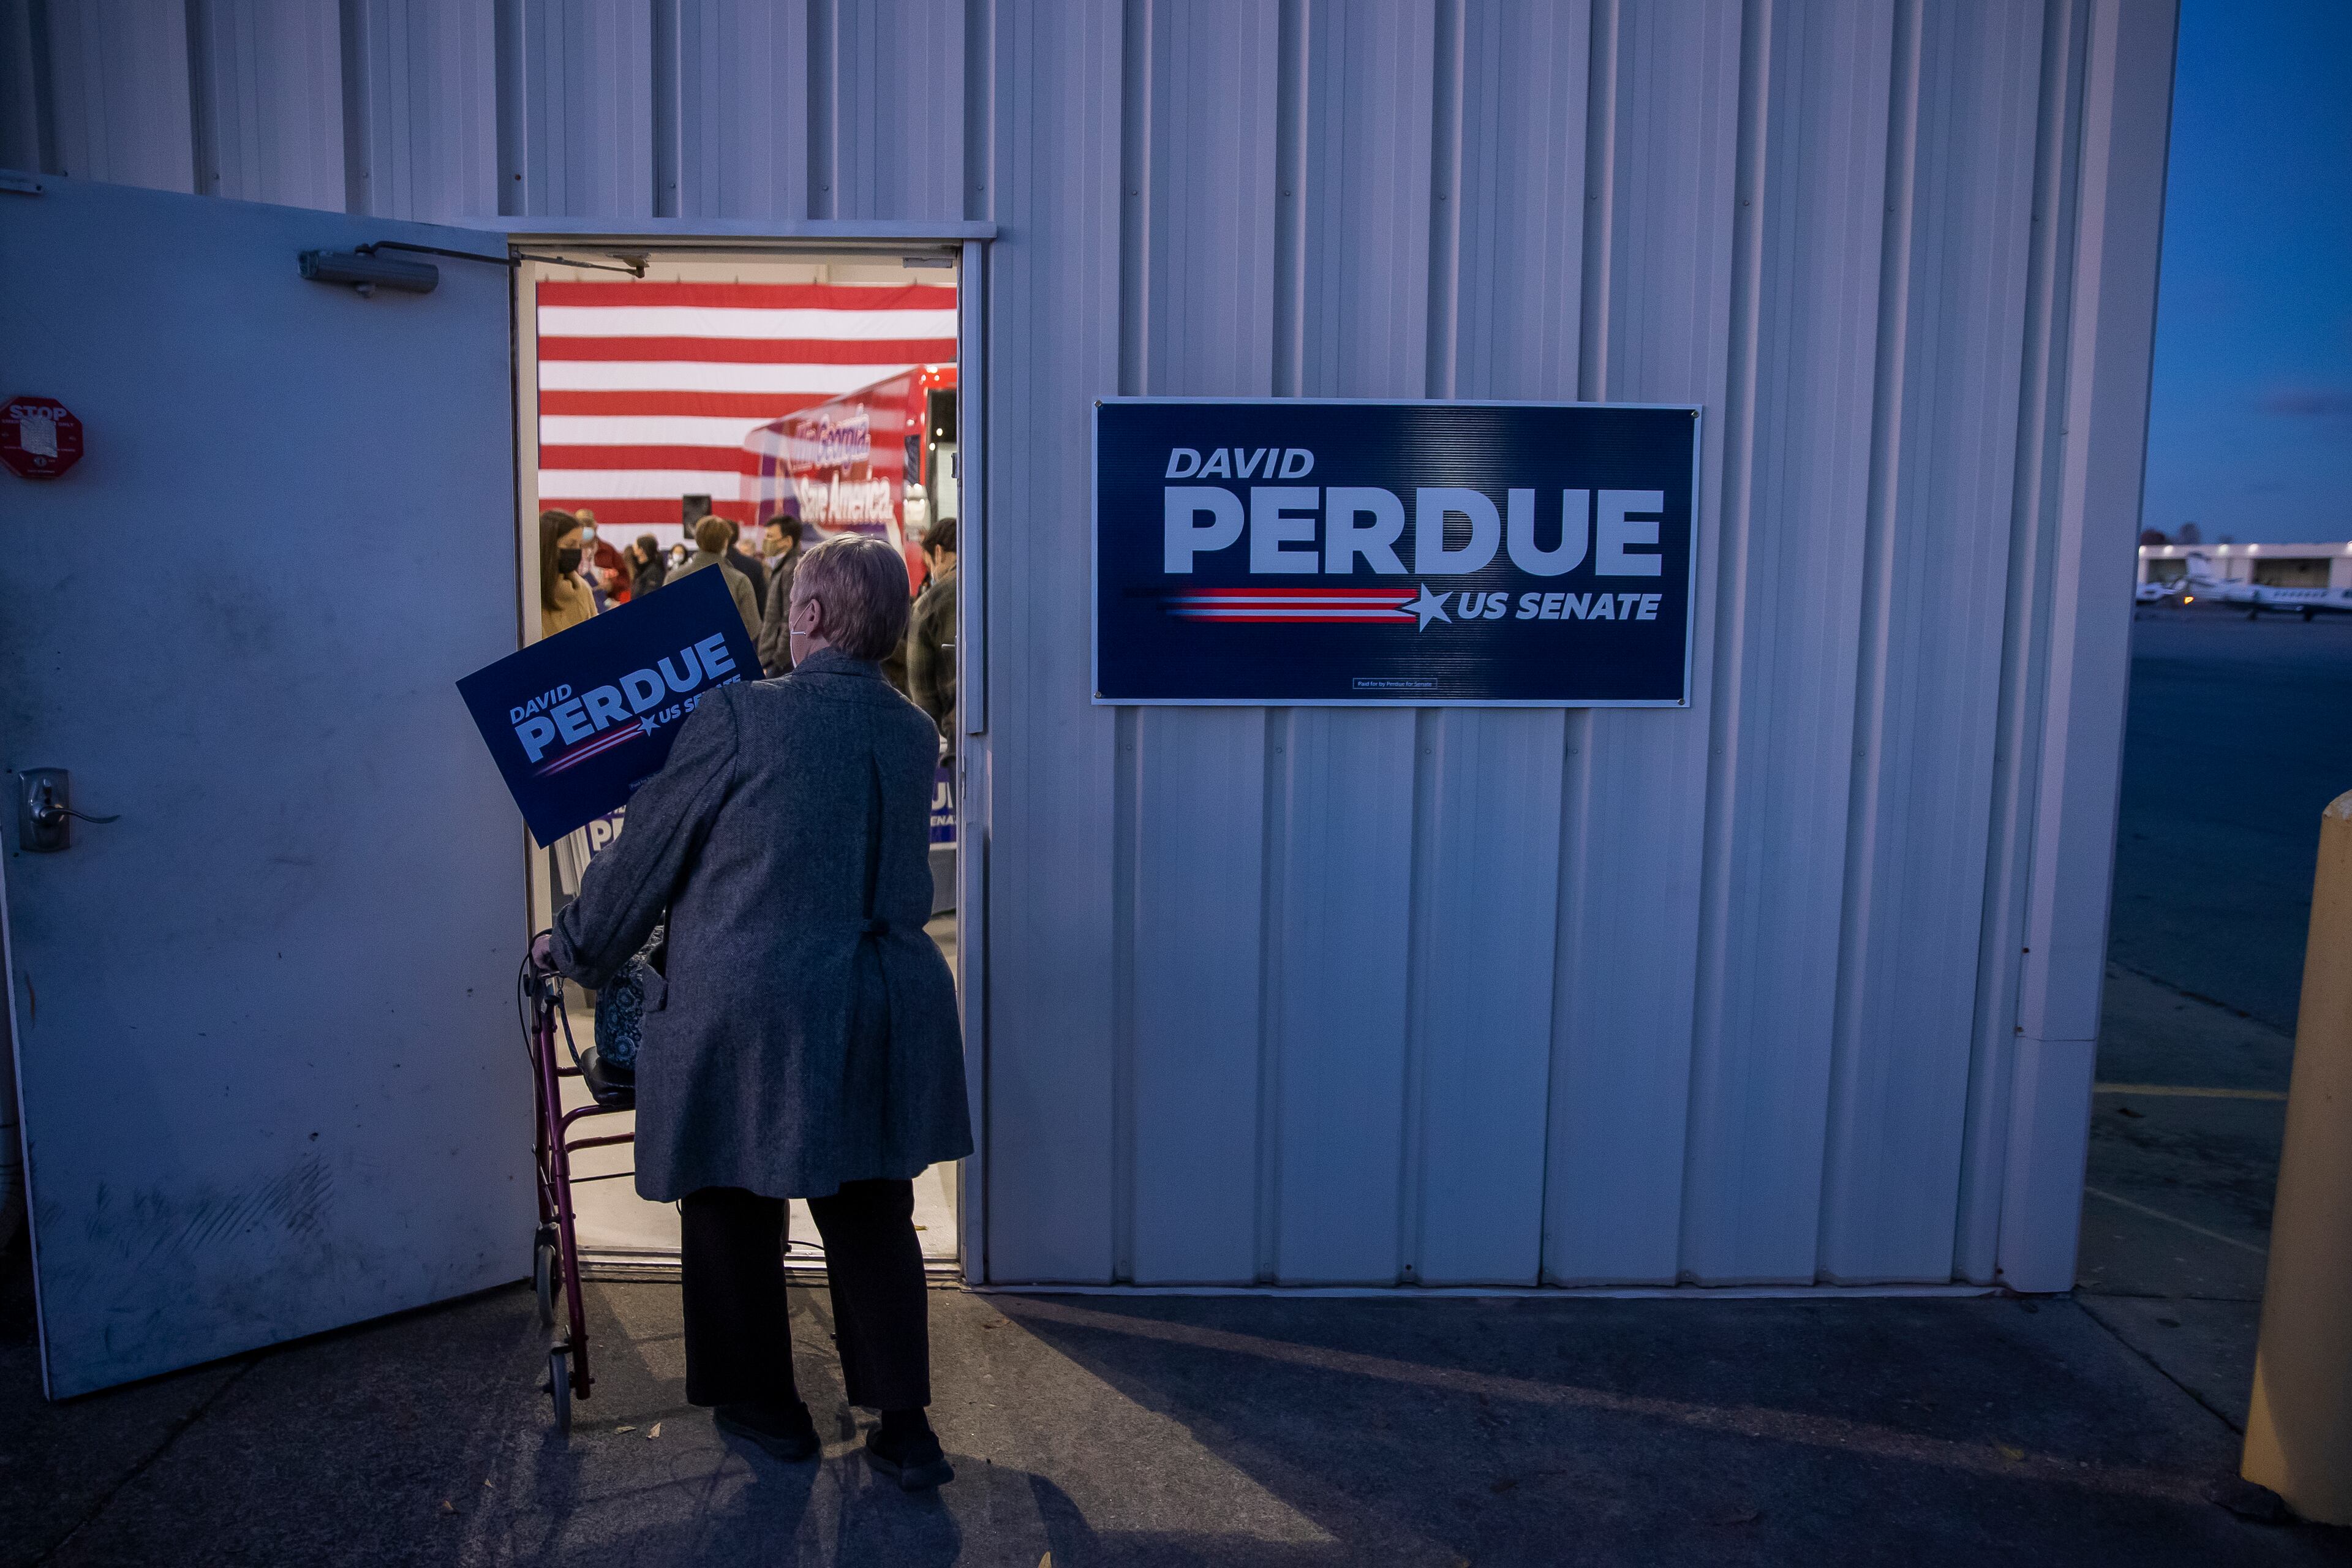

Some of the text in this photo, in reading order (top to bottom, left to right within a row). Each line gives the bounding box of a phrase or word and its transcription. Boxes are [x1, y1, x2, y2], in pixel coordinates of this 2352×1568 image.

[9, 405, 67, 421] STOP
[1165, 448, 1314, 478] DAVID
[1164, 486, 1664, 576] PERDUE
[1457, 592, 1662, 620] US SENATE
[510, 684, 572, 724] DAVID
[514, 631, 736, 764] PERDUE
[659, 674, 741, 723] US SETE
